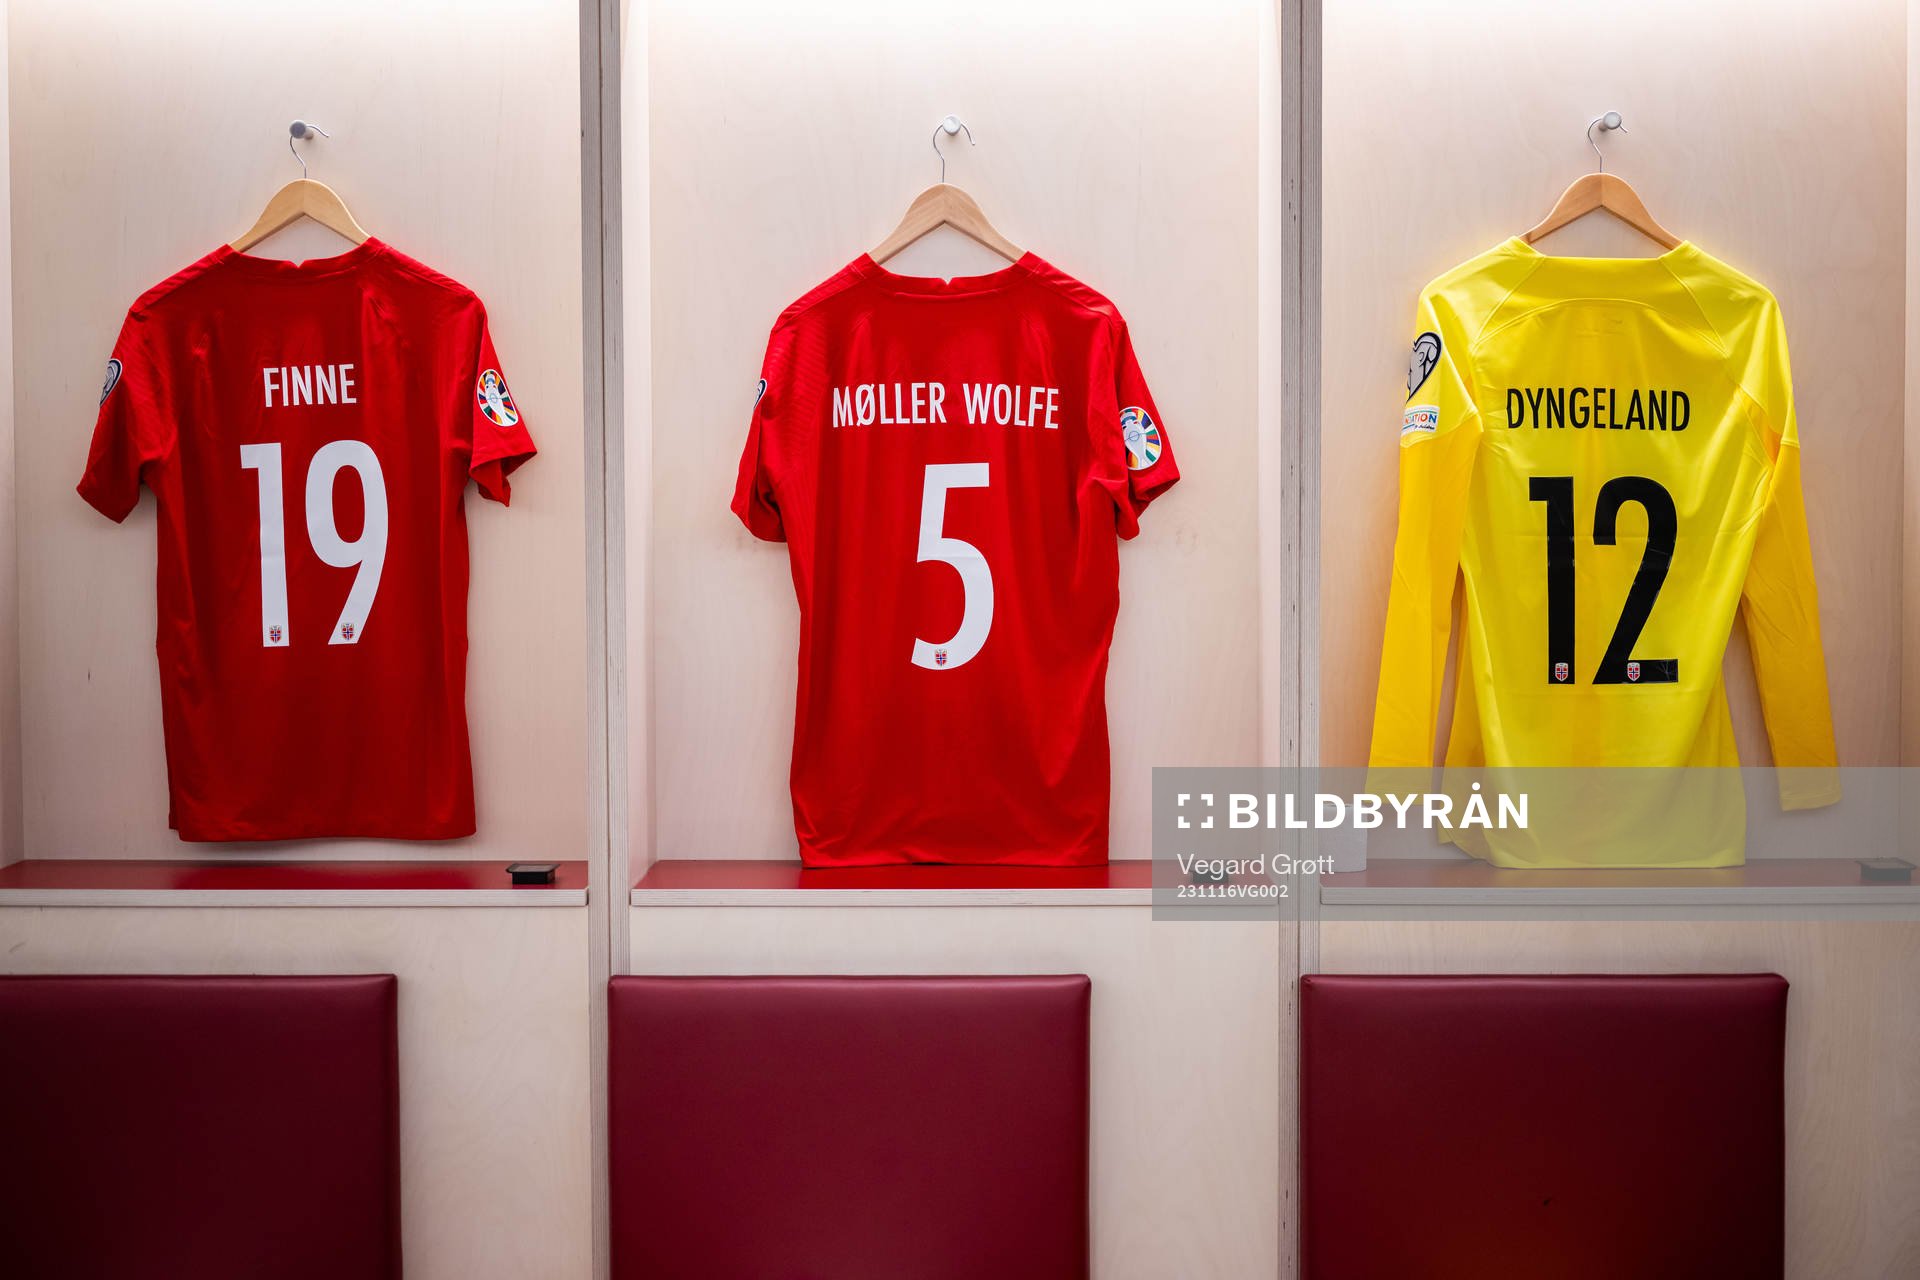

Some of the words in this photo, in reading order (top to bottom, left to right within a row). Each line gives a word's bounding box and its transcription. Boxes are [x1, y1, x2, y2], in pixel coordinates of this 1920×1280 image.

[263, 363, 357, 408] FINNE
[832, 382, 947, 428] MØLLER
[963, 384, 1060, 430] WOLFE
[1506, 387, 1690, 432] DYNGELAND
[240, 439, 389, 648] 19
[911, 462, 995, 670] 5
[1529, 476, 1678, 685] 12
